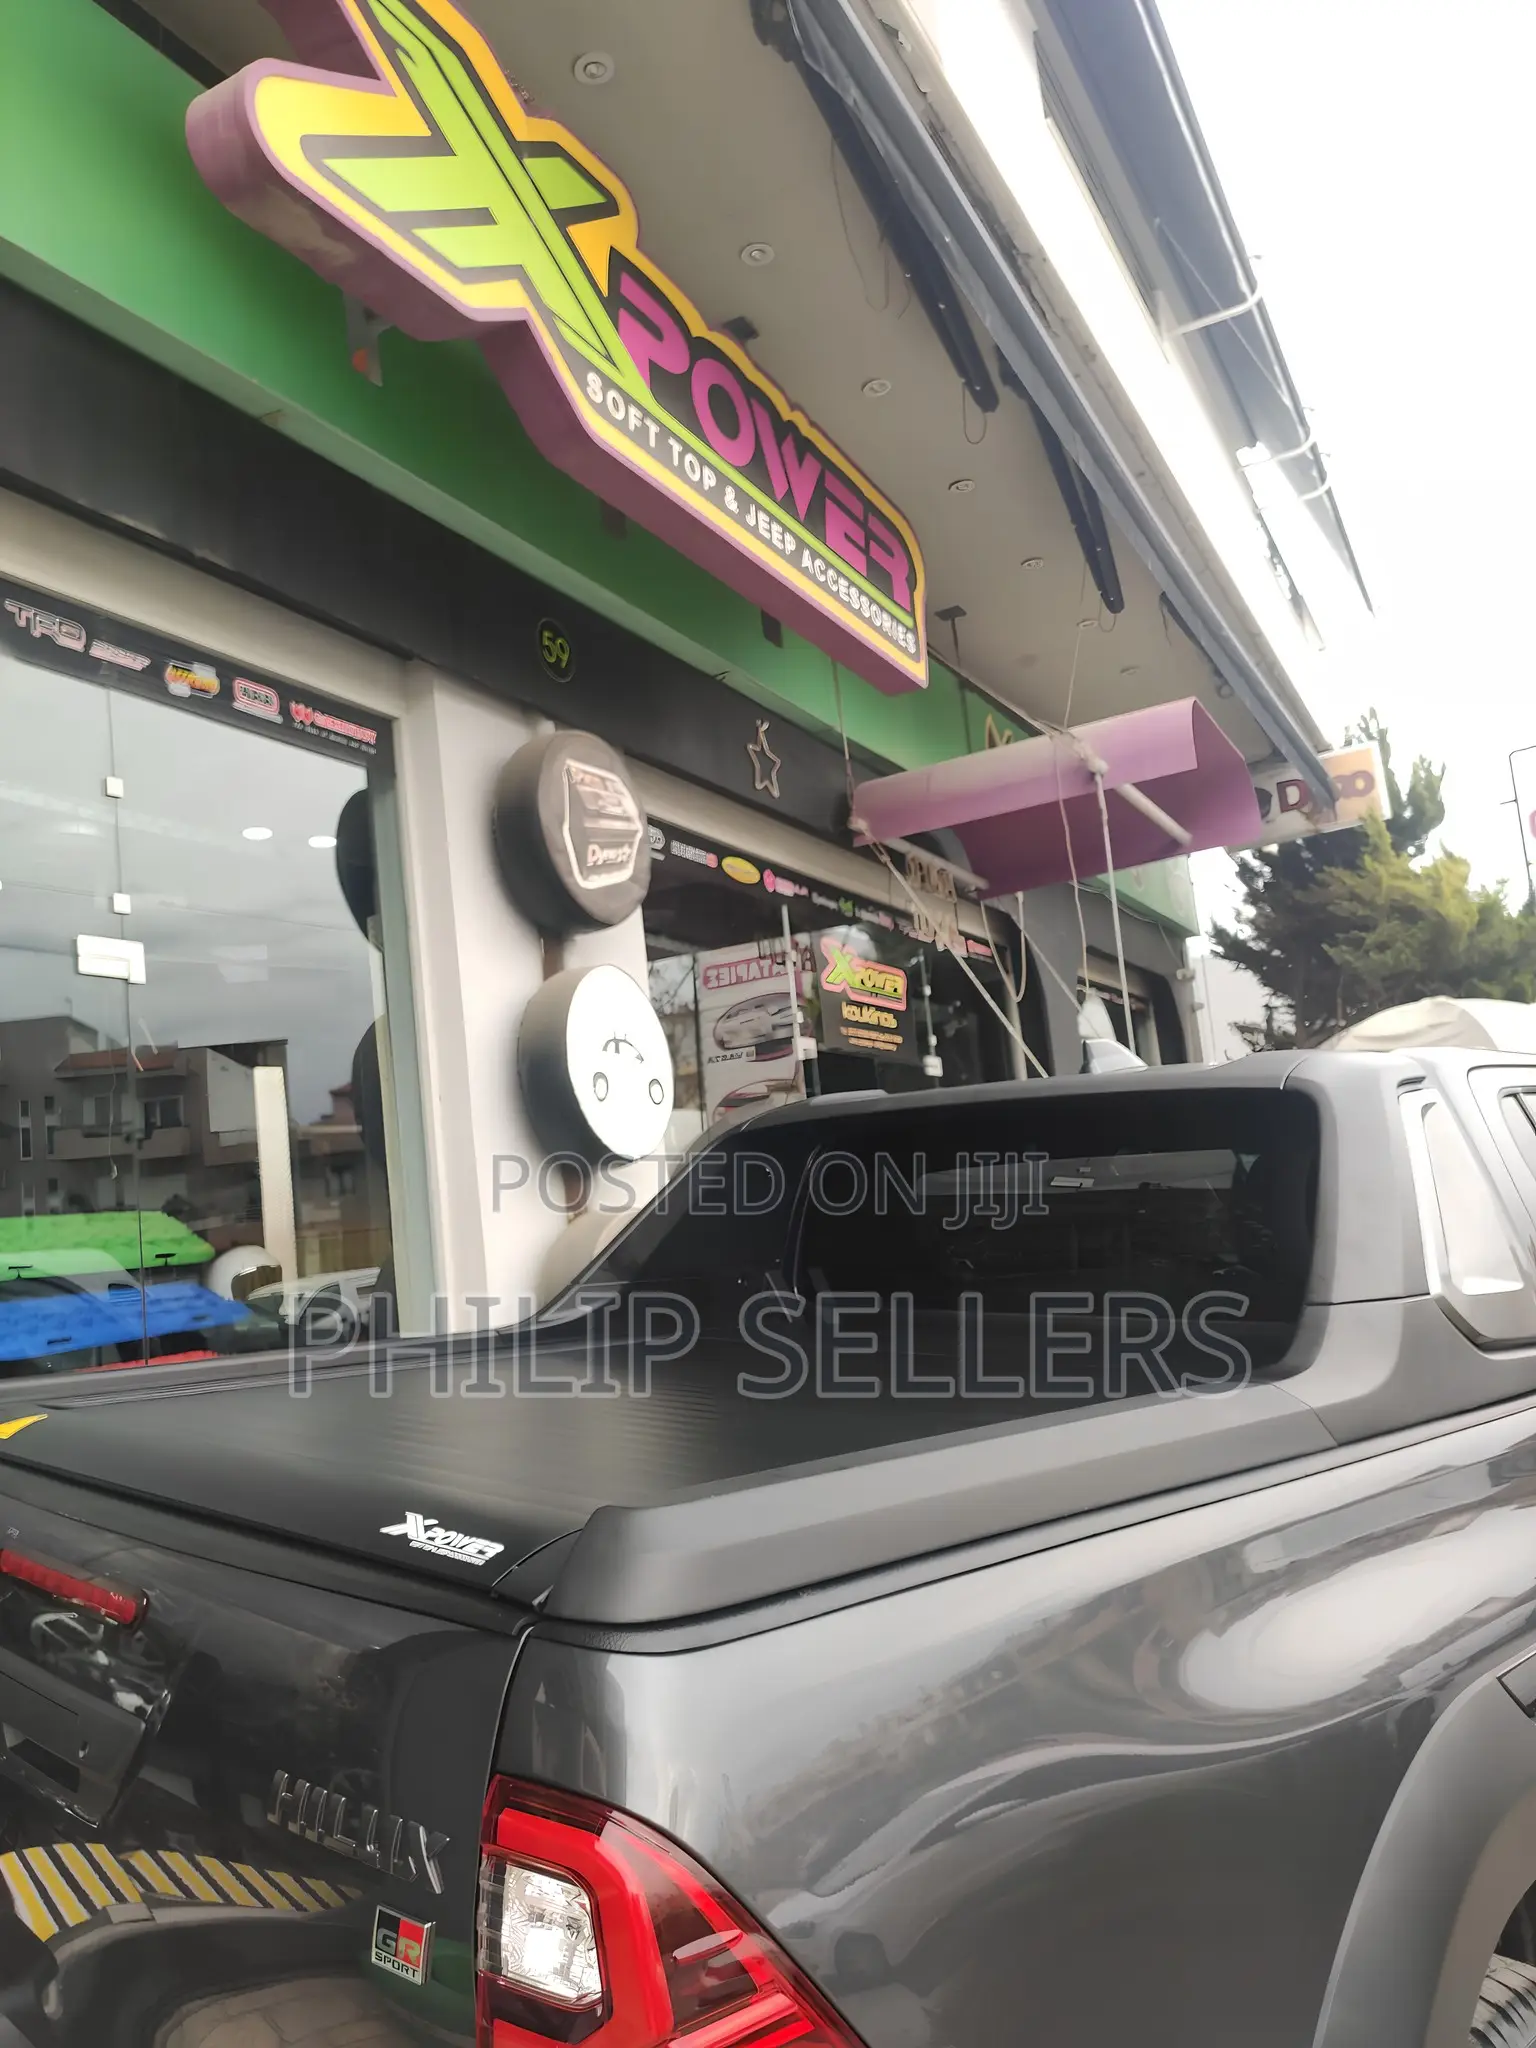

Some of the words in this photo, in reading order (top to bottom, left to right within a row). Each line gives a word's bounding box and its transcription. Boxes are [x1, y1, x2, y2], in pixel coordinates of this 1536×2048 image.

[586, 371, 660, 448] SOFT
[667, 436, 717, 491] TOP
[724, 485, 740, 514] &
[745, 503, 796, 555] JEEP
[801, 548, 917, 654] ACCESSORIES
[542, 630, 570, 668] 59
[374, 1950, 419, 1979] SPORT
[376, 1927, 421, 1965] GR
